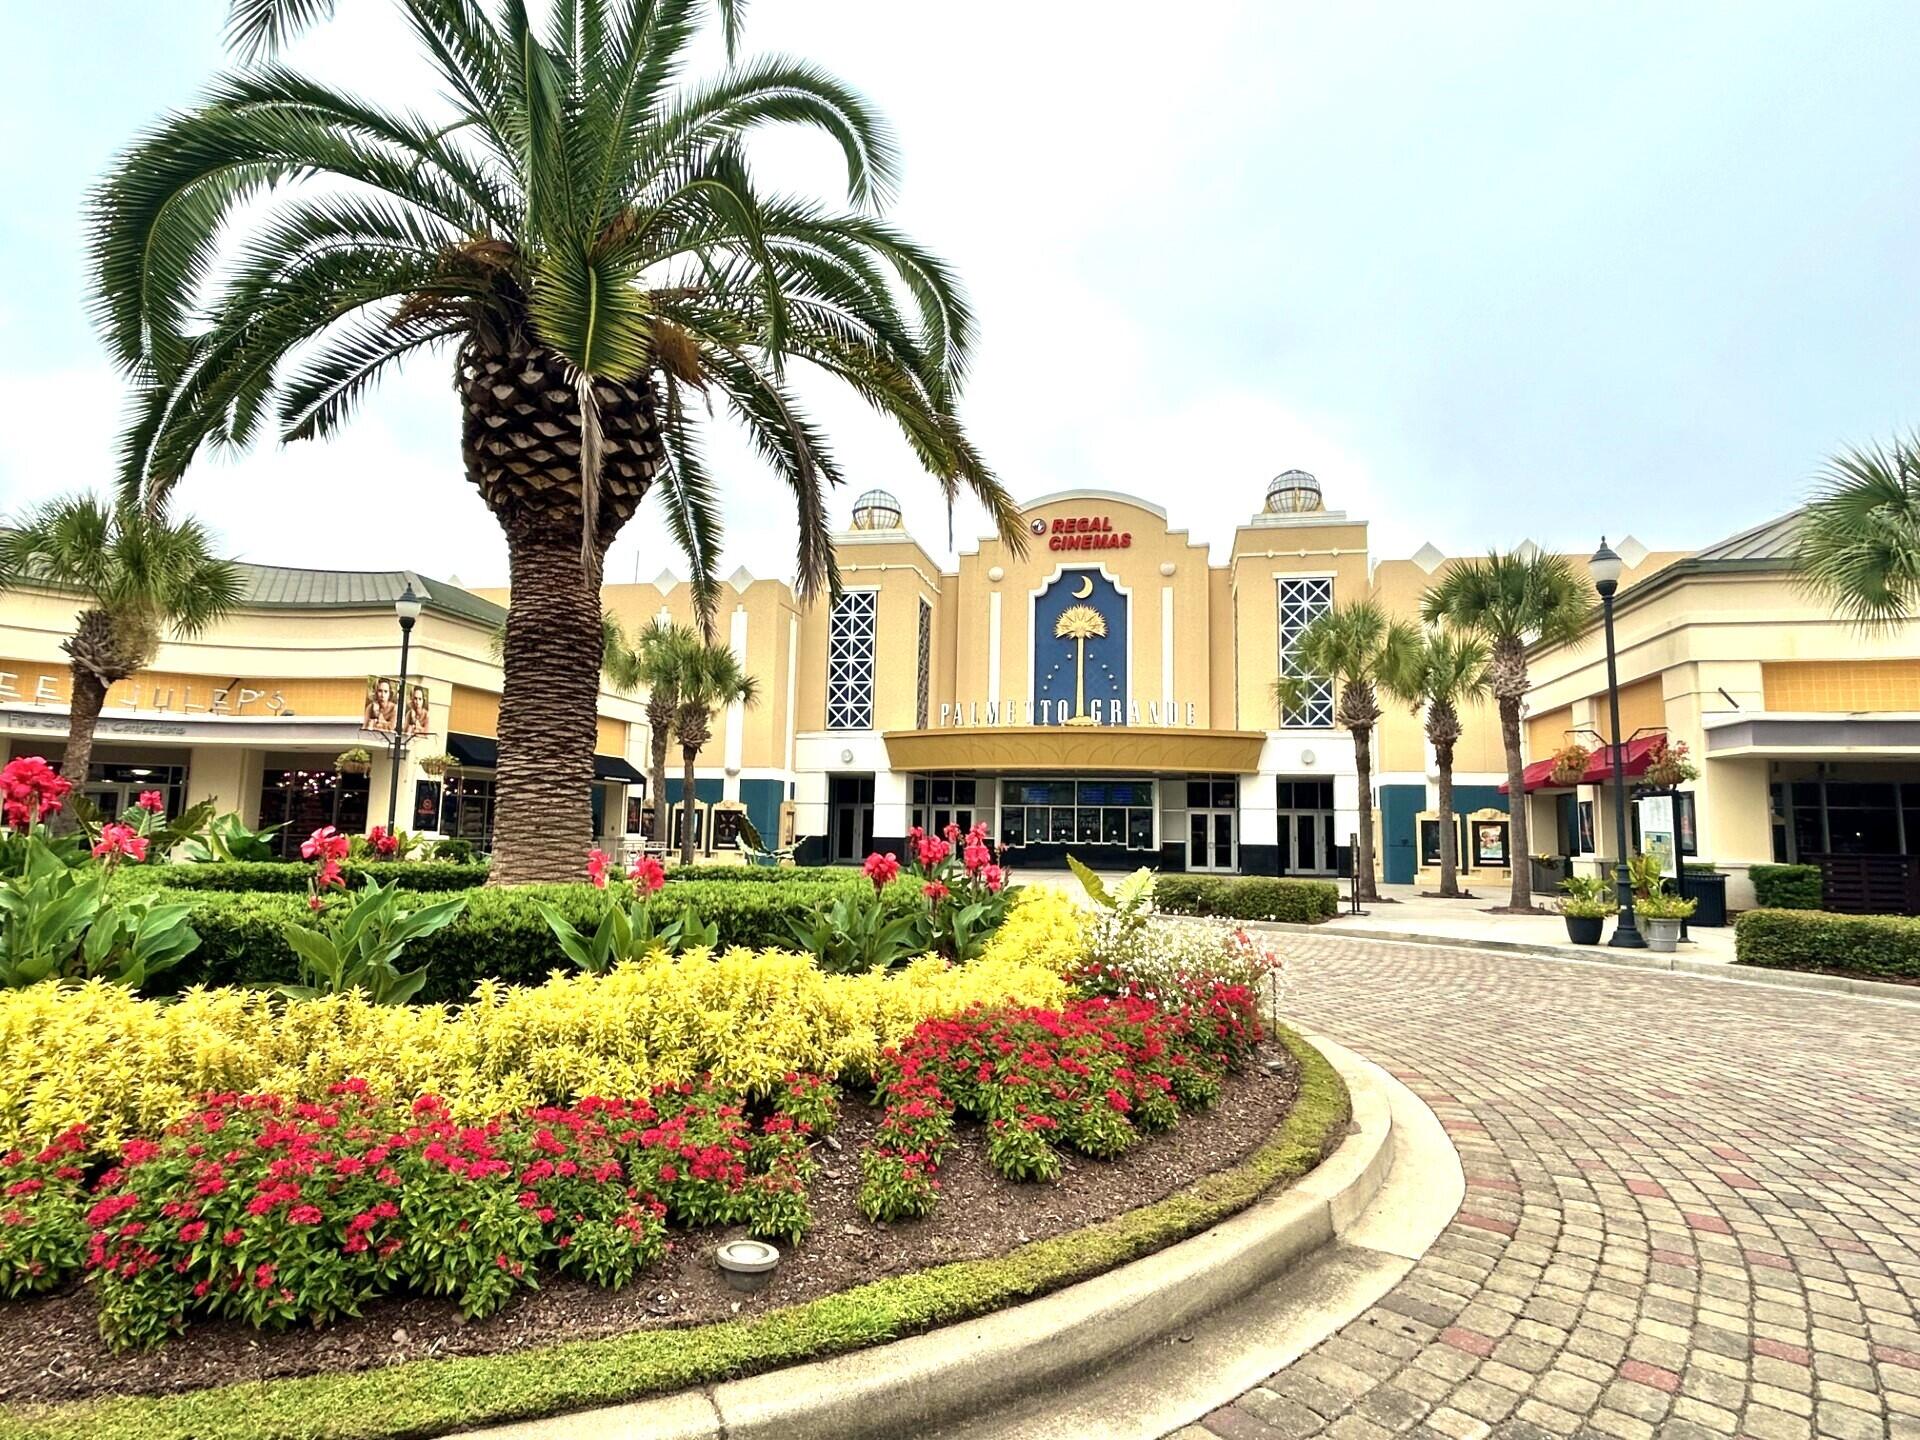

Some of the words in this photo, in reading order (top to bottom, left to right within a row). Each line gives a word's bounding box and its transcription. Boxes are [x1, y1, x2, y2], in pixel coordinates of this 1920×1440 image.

[1051, 516, 1113, 534] REGAL
[1048, 532, 1132, 552] CINEMAS
[118, 684, 285, 711] JULEP'S
[940, 699, 1069, 727] PALMETTO
[1090, 698, 1197, 727] GRANDE
